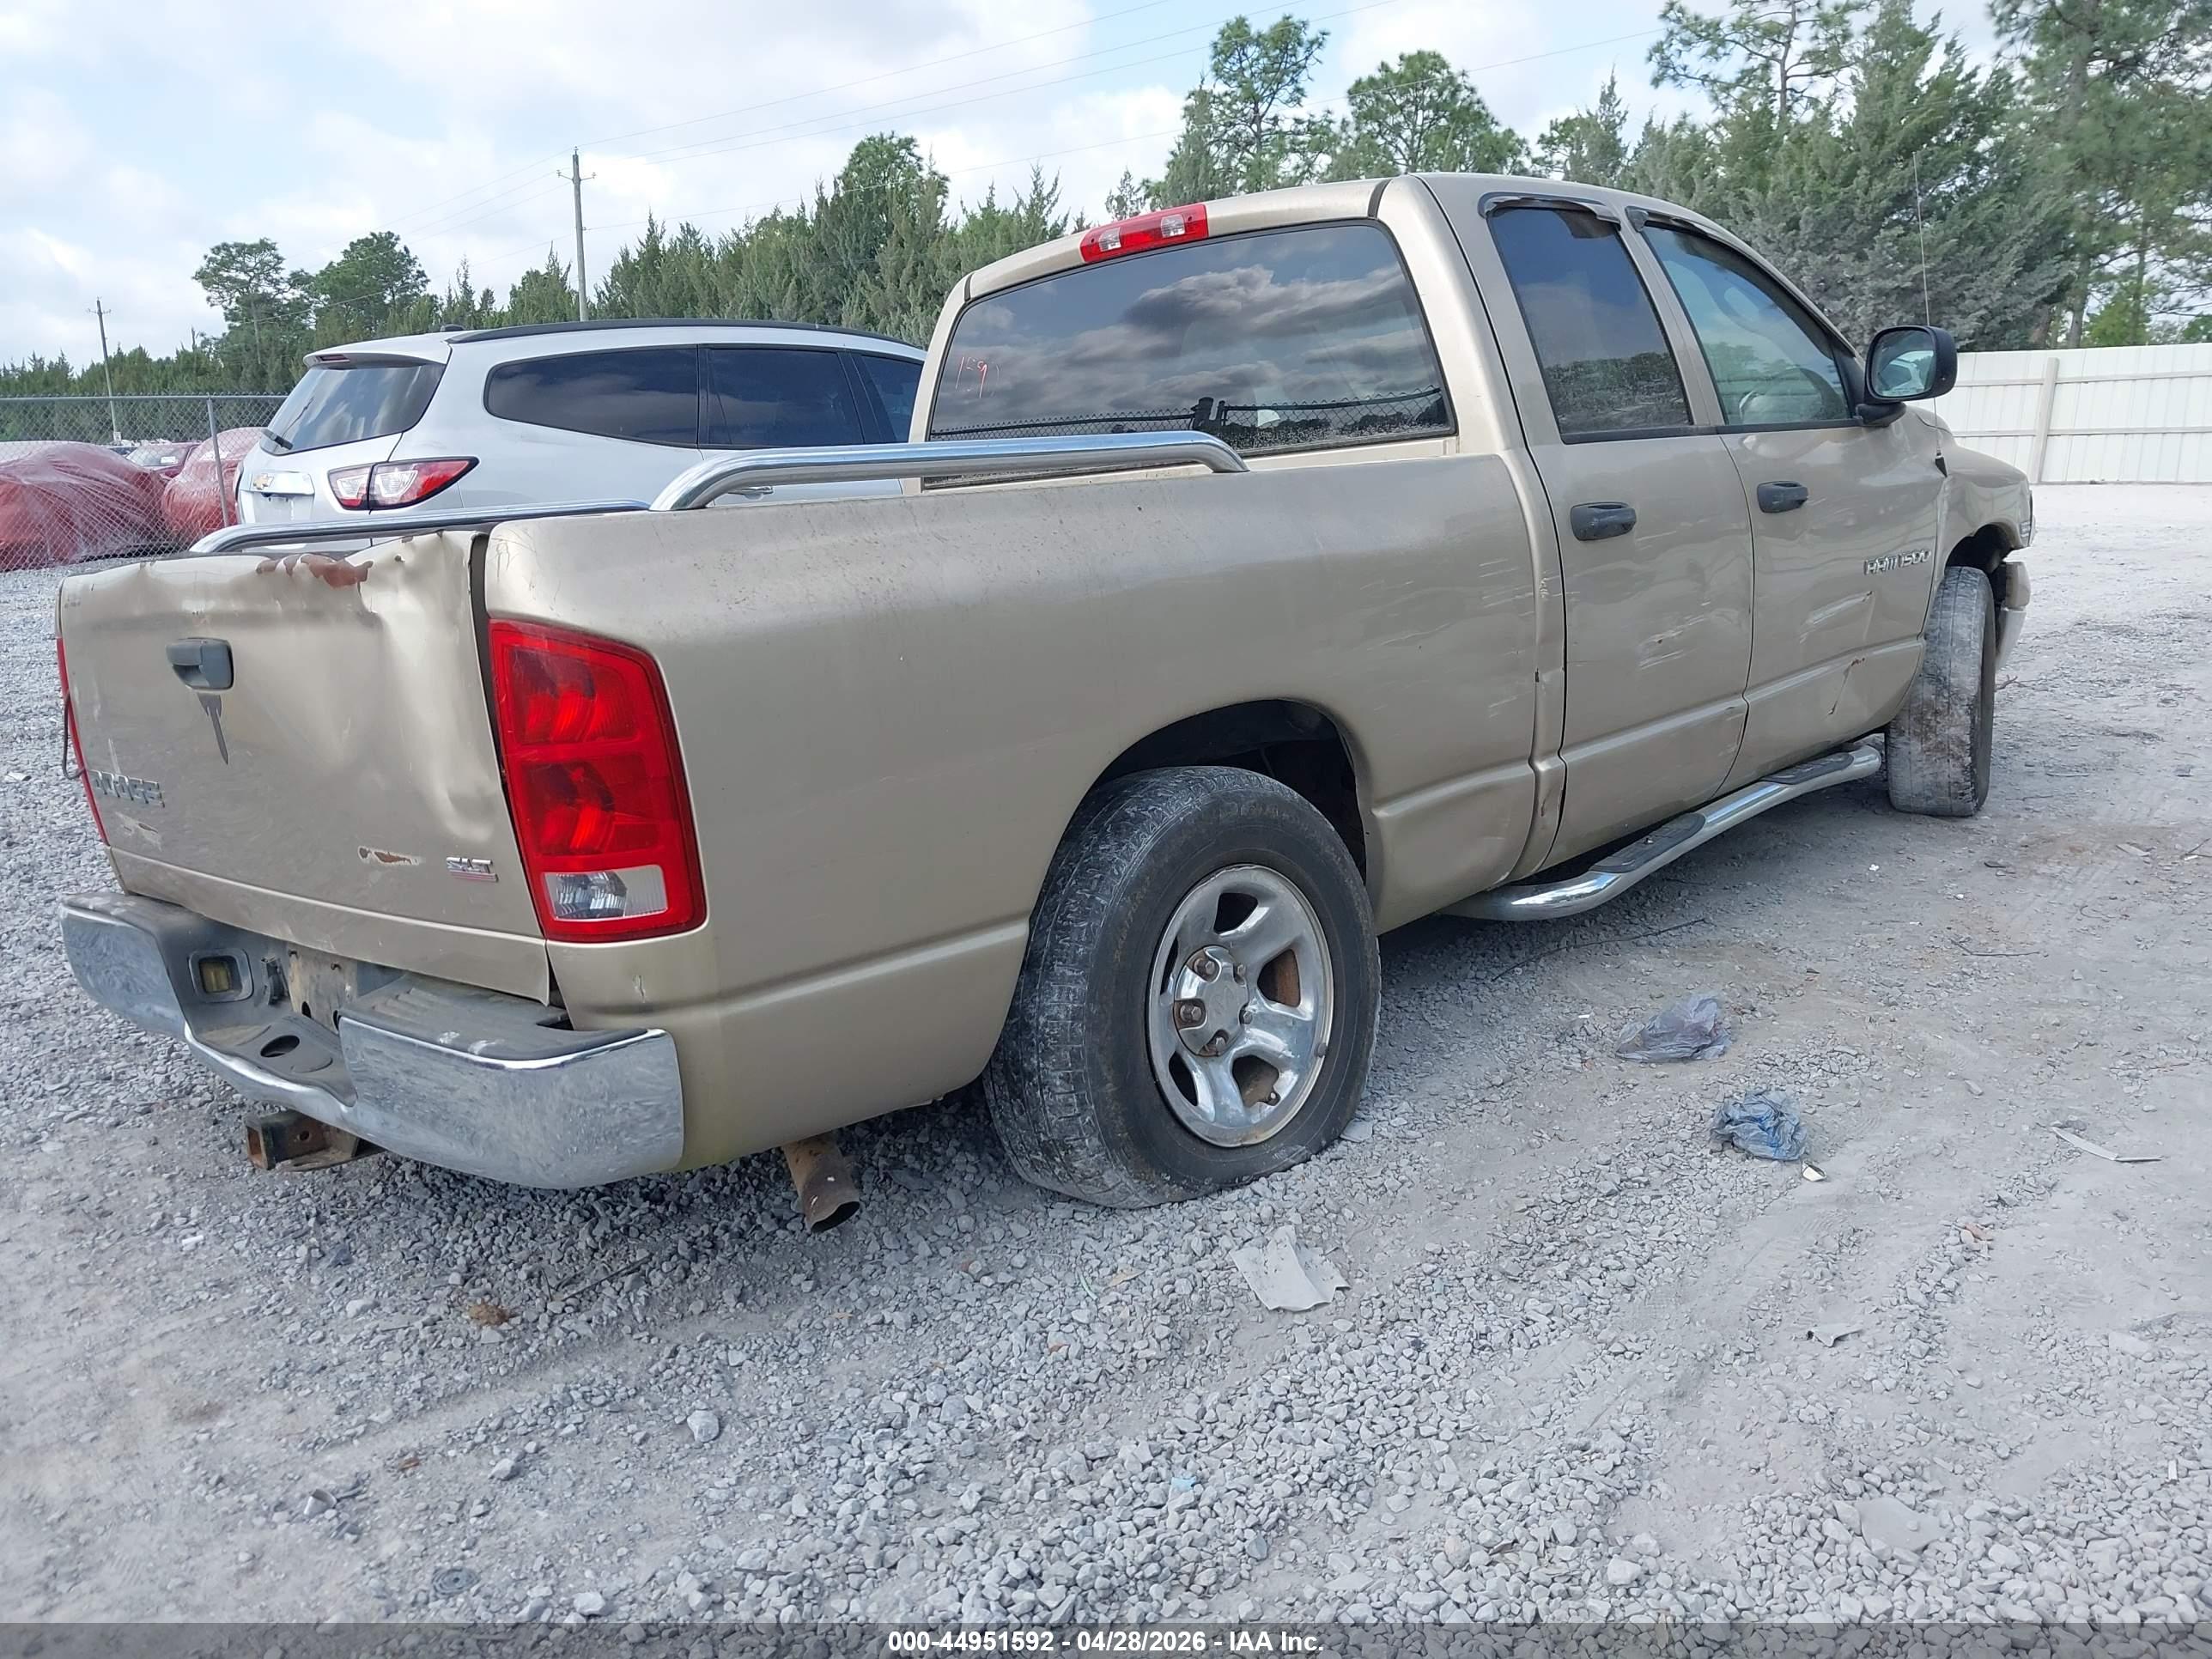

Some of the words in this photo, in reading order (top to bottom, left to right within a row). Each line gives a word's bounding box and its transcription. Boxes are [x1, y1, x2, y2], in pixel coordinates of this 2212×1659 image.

[1898, 549, 1931, 568] 1500
[88, 769, 165, 808] DODGE
[446, 856, 494, 875] SLT
